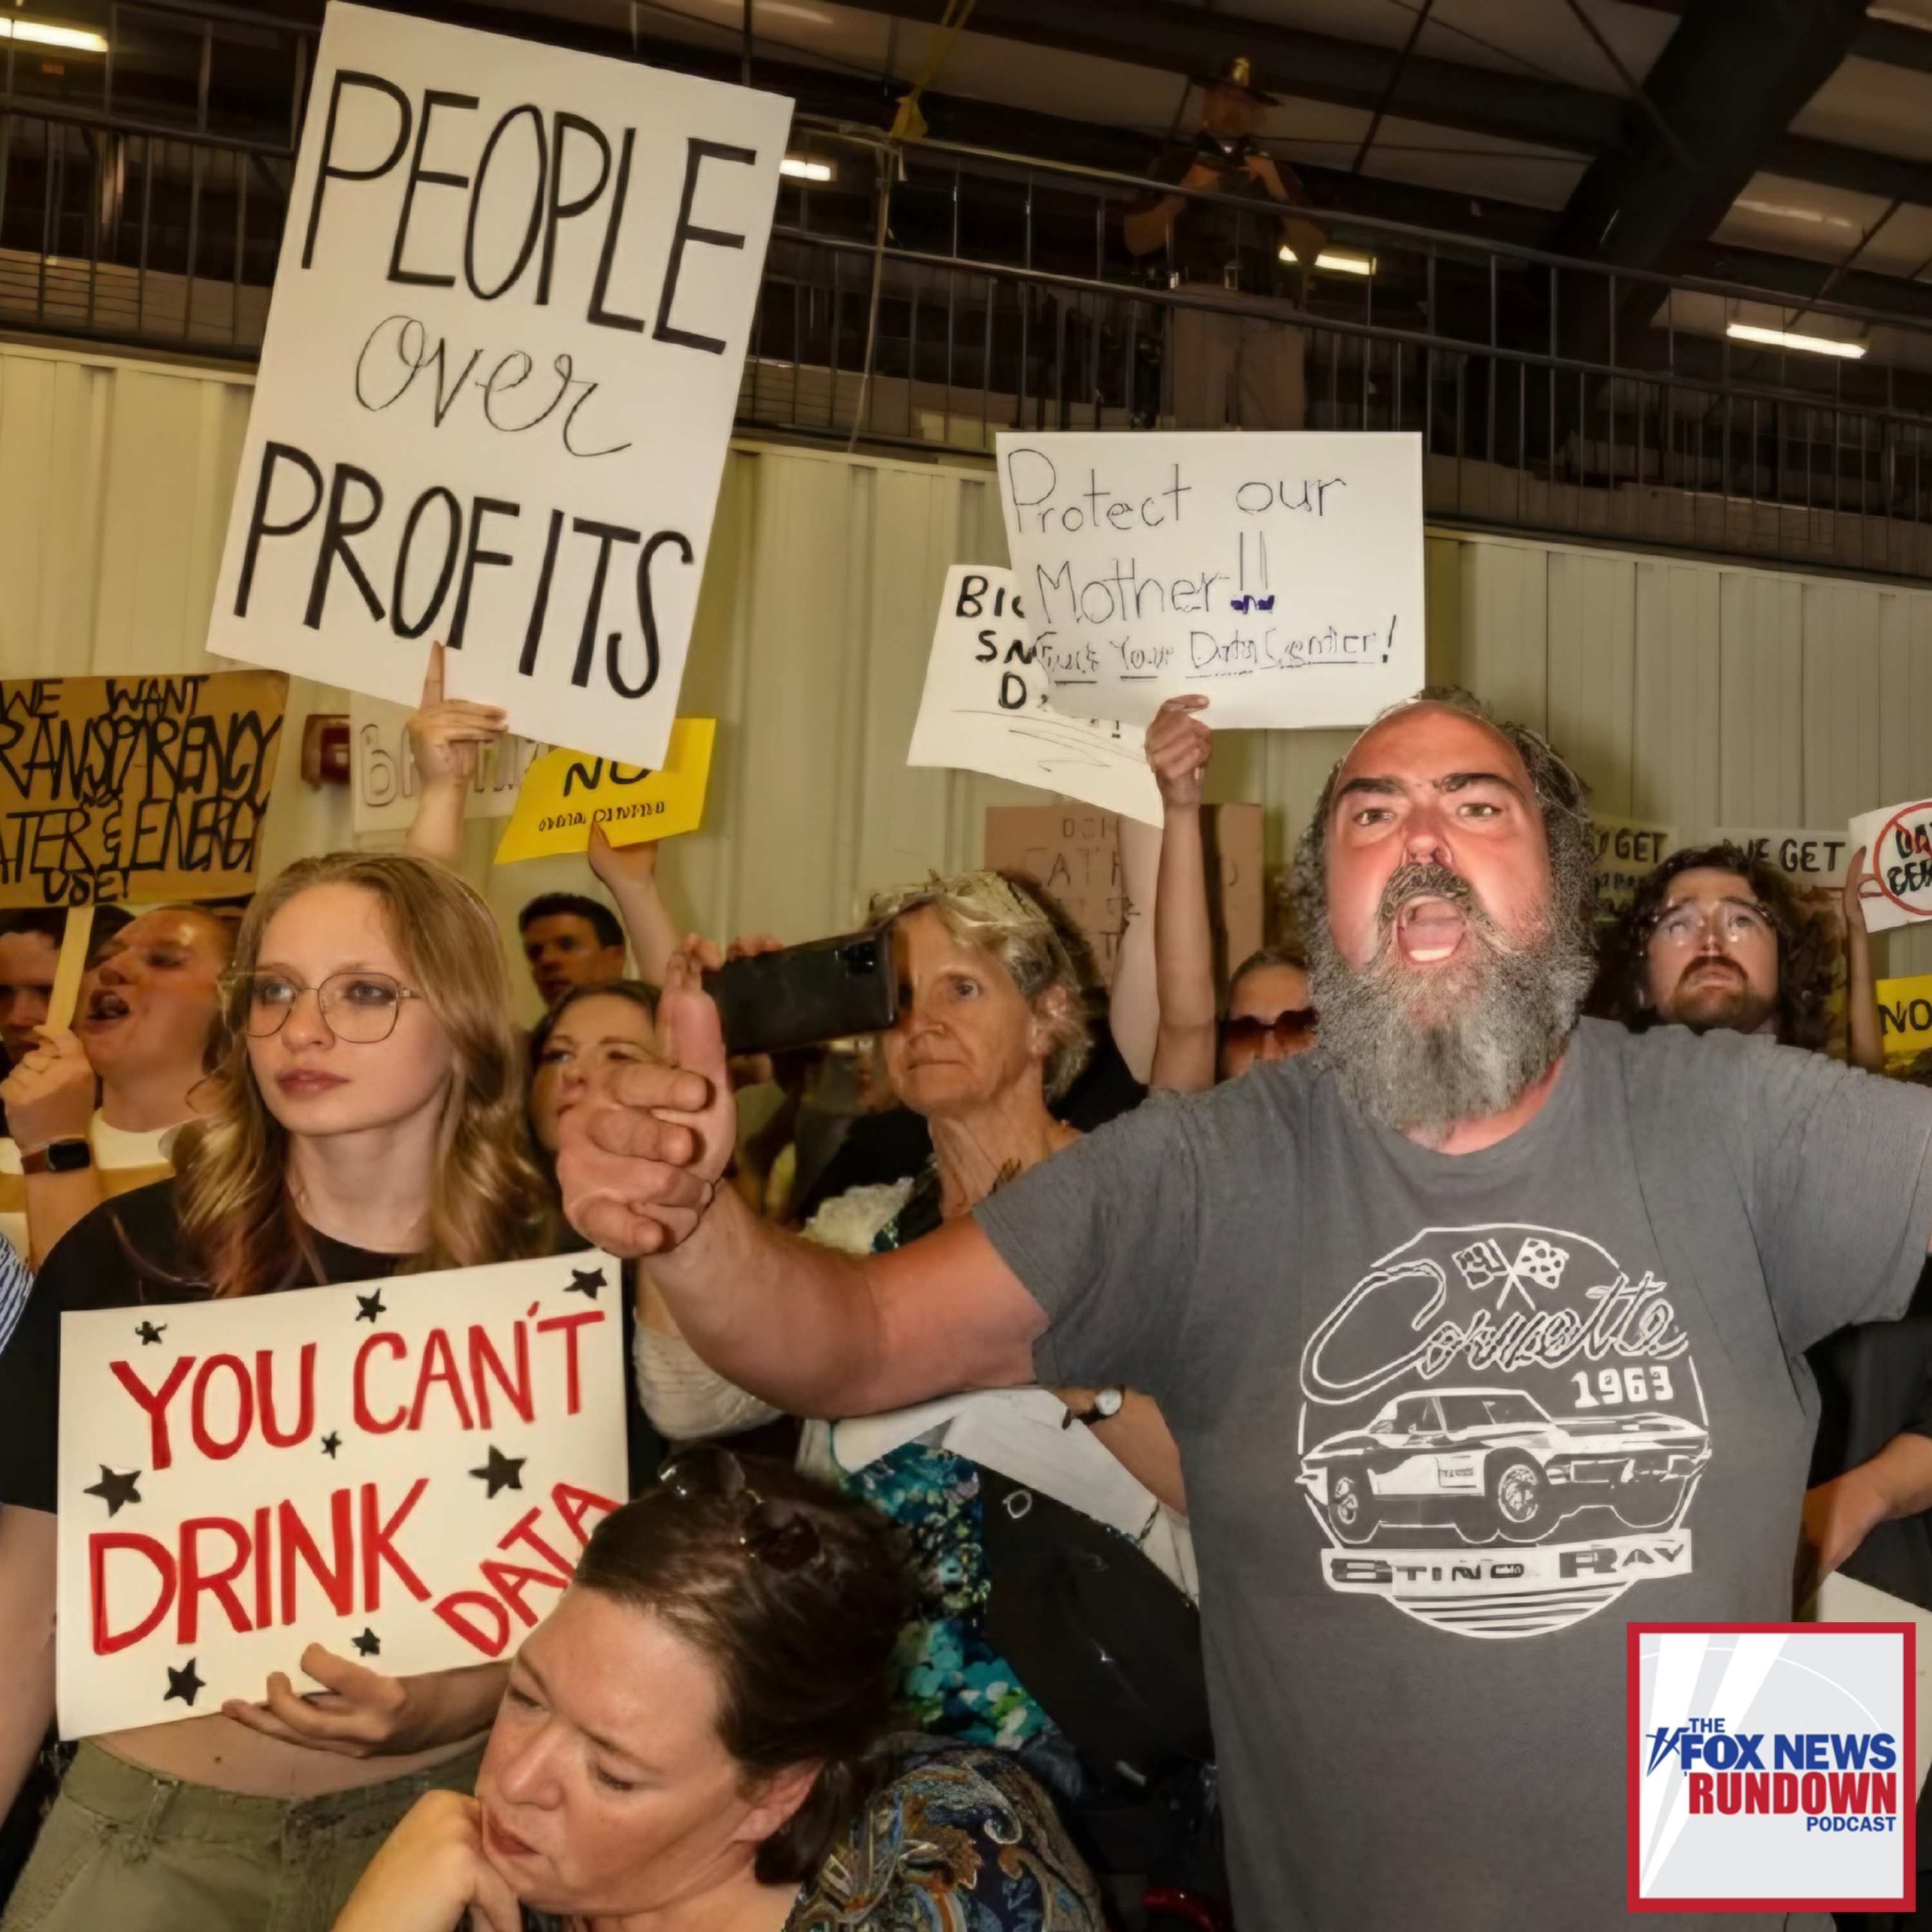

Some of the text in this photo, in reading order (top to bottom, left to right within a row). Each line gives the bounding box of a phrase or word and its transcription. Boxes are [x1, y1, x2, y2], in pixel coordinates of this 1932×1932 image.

[301, 68, 757, 355] PEOPLE
[1007, 448, 1347, 533] Protect our
[233, 440, 694, 699] PROFITS
[105, 674, 210, 715] WANT
[0, 710, 283, 800] RANSPARENCY
[1615, 828, 1669, 864] GET
[1779, 838, 1846, 872] GET
[1878, 998, 1932, 1035] NO
[1300, 1258, 1689, 1405] Corvette
[109, 1301, 605, 1471] YOU CAN'T
[1571, 1365, 1674, 1408] 1963
[88, 1478, 622, 1658] DRINK DATA
